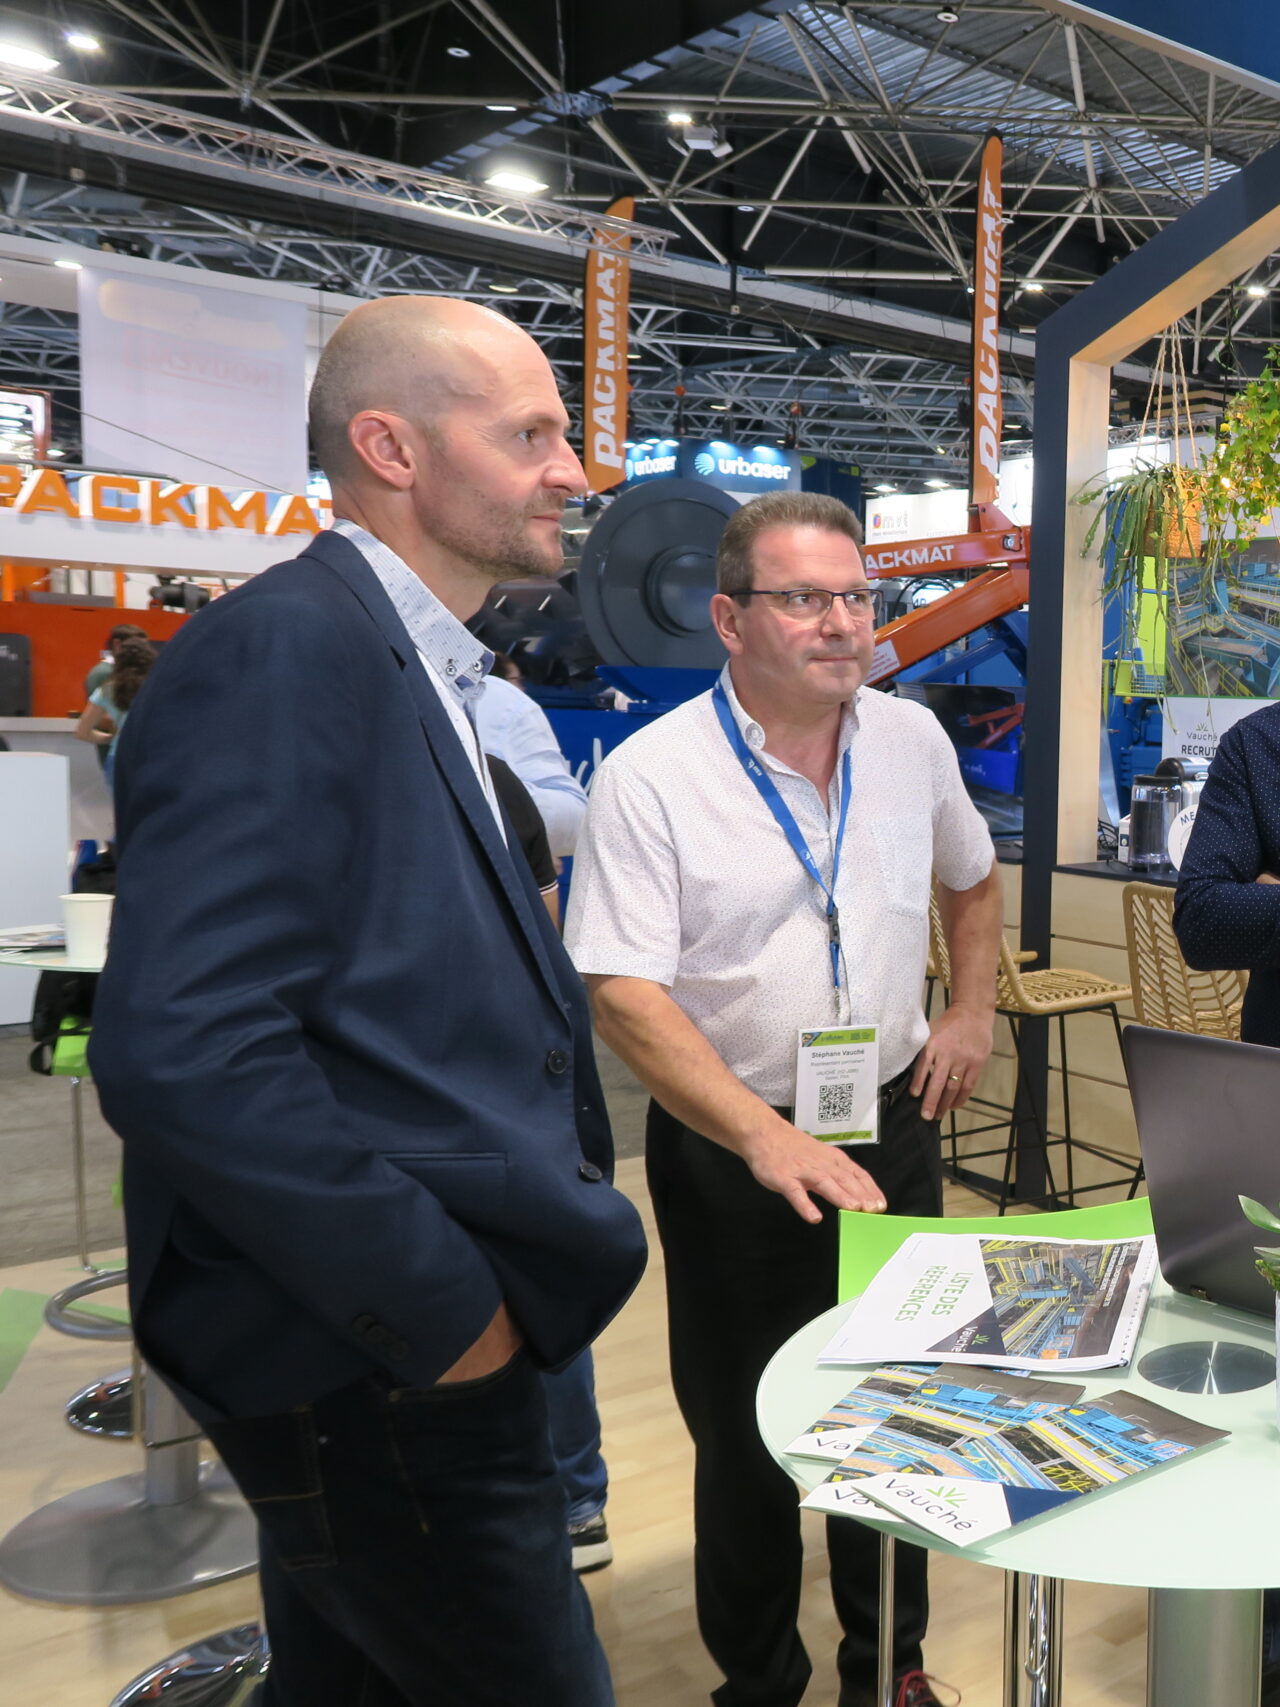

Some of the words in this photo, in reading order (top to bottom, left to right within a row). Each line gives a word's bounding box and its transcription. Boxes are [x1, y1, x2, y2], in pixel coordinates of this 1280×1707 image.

[593, 235, 623, 470] PACKMAT
[634, 455, 678, 477] urbaser
[717, 456, 792, 480] urbaser
[894, 1265, 949, 1322] RÉFÉRENCES
[944, 1272, 974, 1295] LISTE
[931, 1296, 960, 1316] DES
[885, 1478, 979, 1531] Vauché
